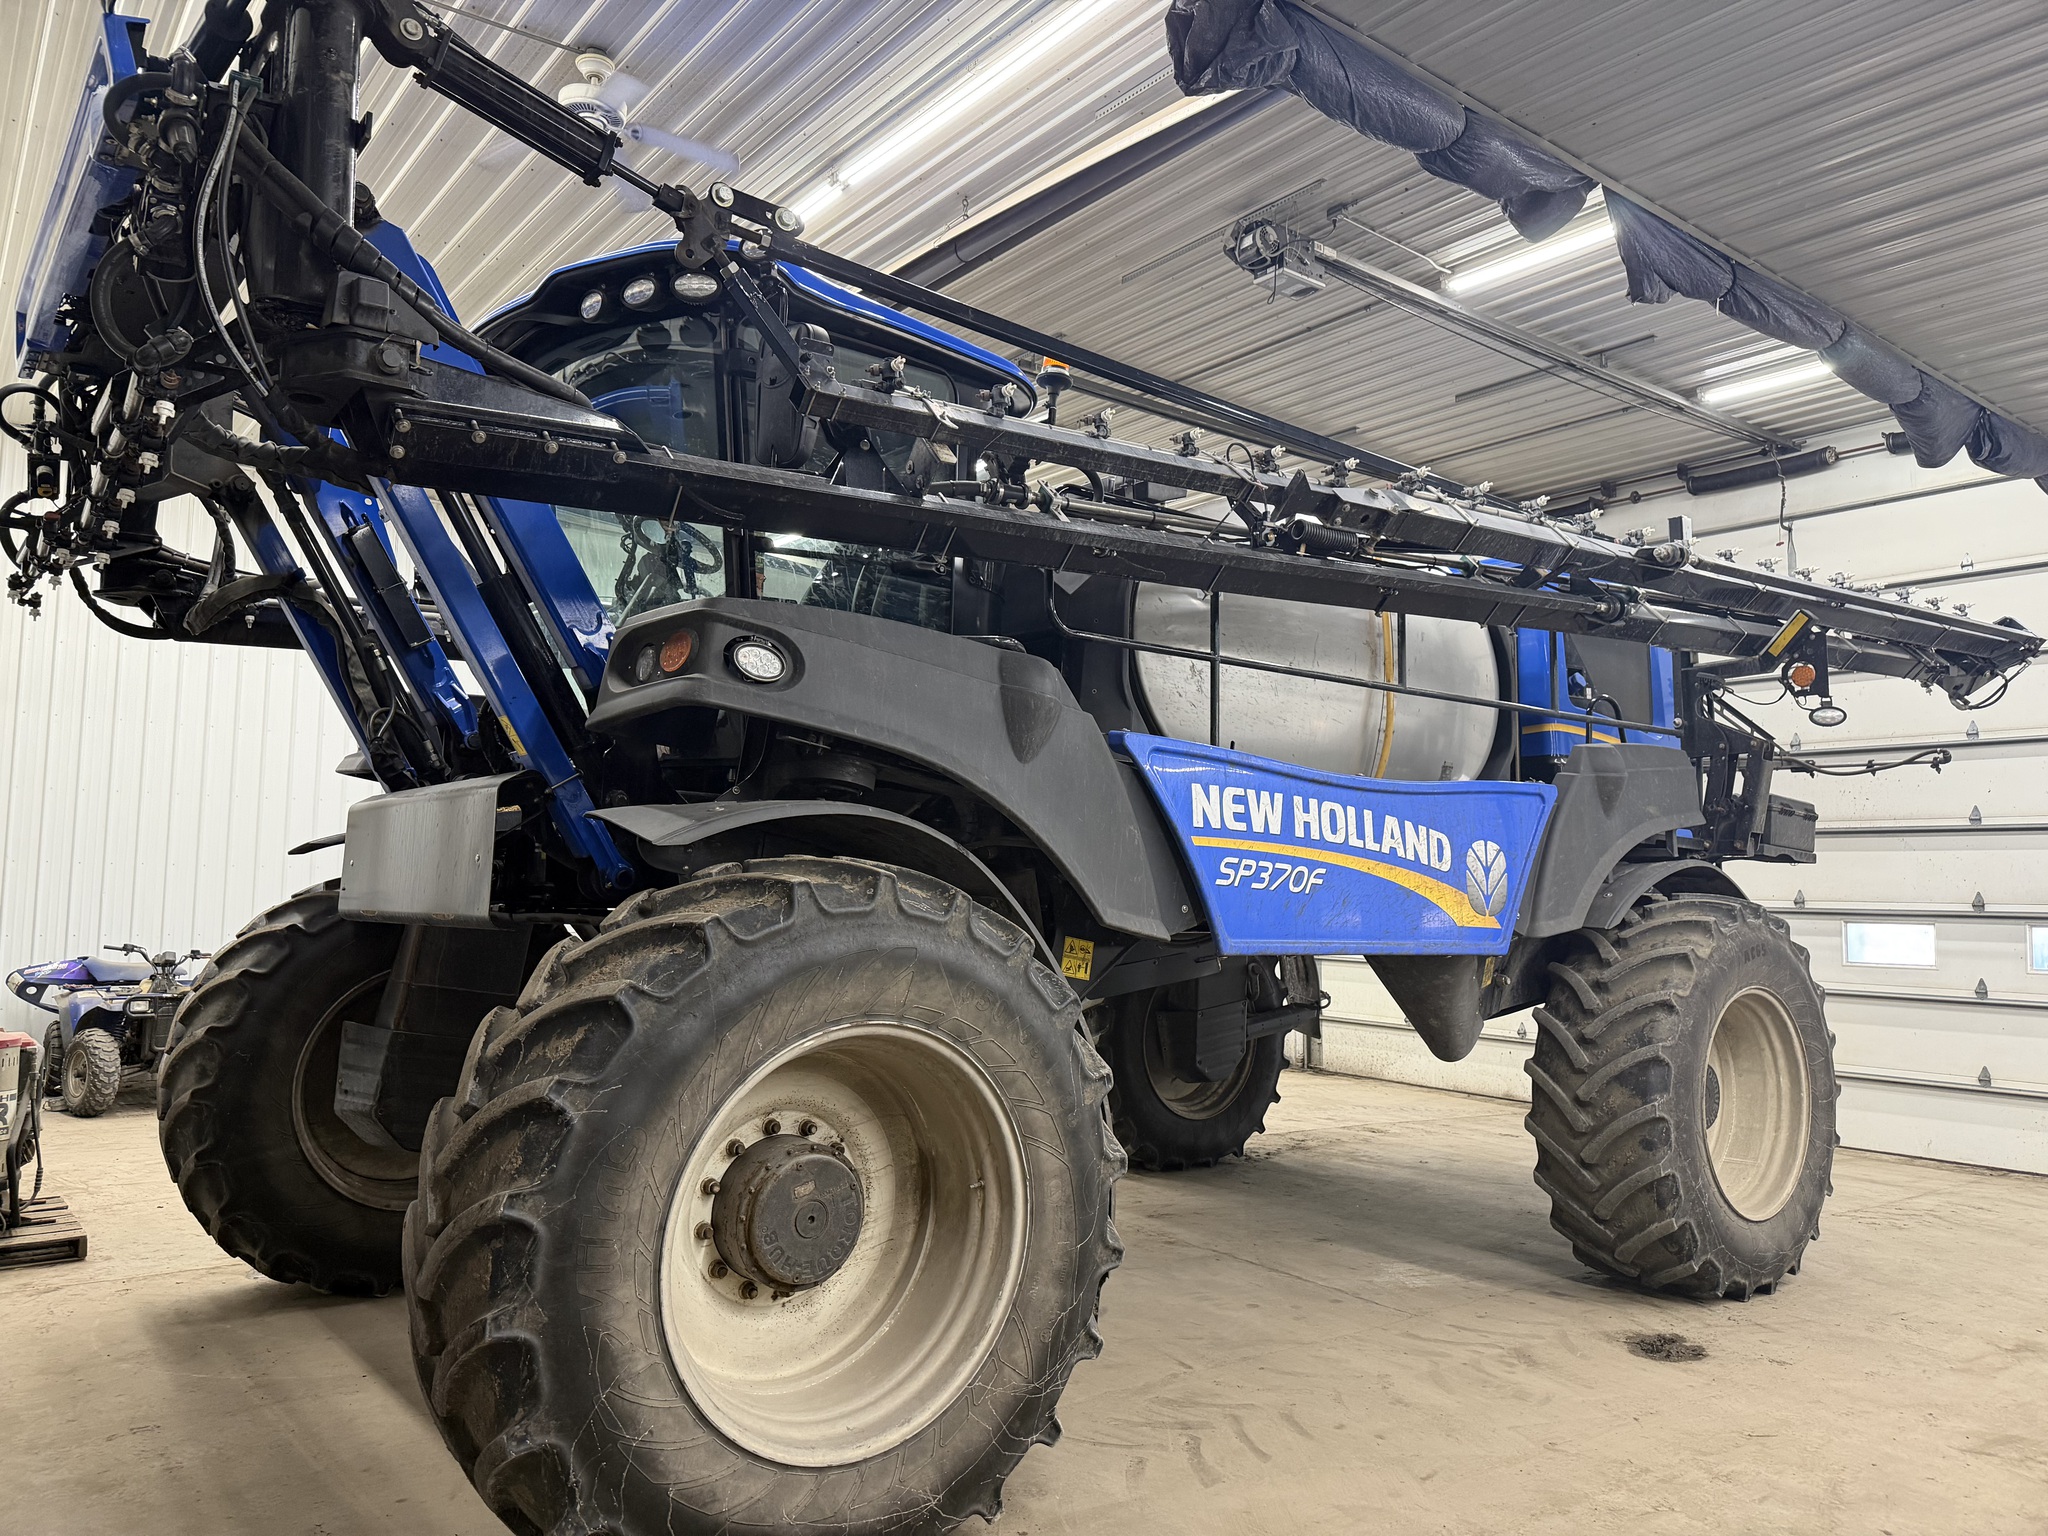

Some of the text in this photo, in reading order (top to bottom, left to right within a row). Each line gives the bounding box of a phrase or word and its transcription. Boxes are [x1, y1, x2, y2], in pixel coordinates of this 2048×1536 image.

[1191, 783, 1452, 873] NEW HOLLAND
[1215, 856, 1327, 895] SP370F
[575, 1121, 648, 1347] Mitas
